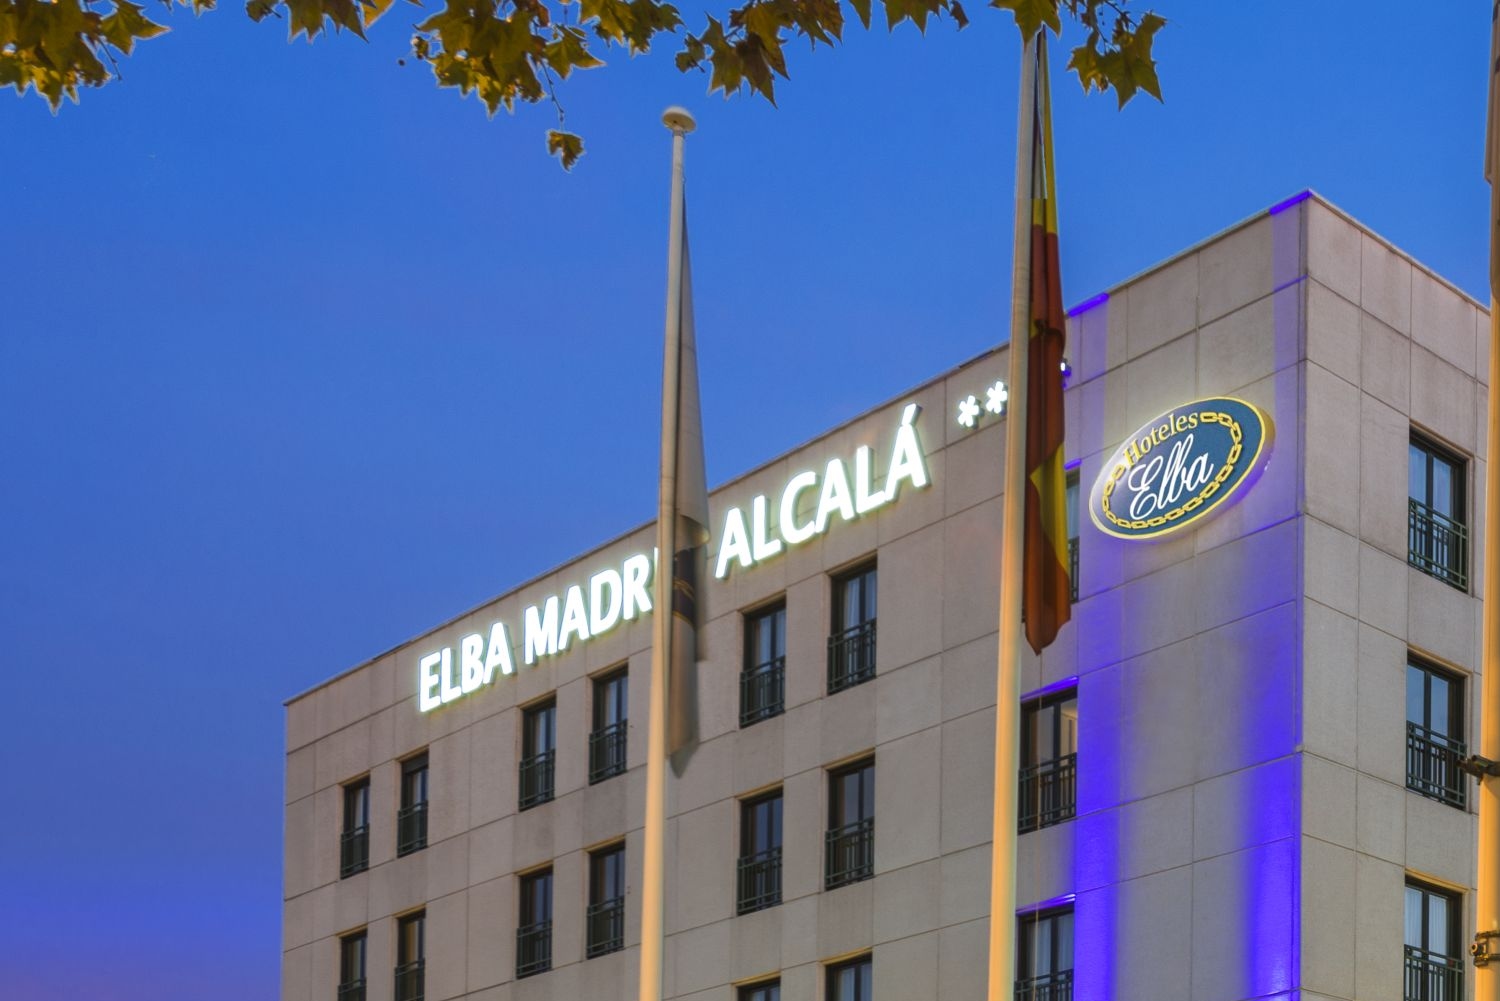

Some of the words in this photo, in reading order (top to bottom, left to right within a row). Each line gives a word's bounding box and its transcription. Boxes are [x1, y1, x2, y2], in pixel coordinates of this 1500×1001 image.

[1122, 411, 1199, 467] Hoteles
[1128, 433, 1214, 520] Elba
[418, 620, 515, 713] ELBA
[523, 547, 659, 664] MADR
[714, 403, 929, 579] ALCALÁ
